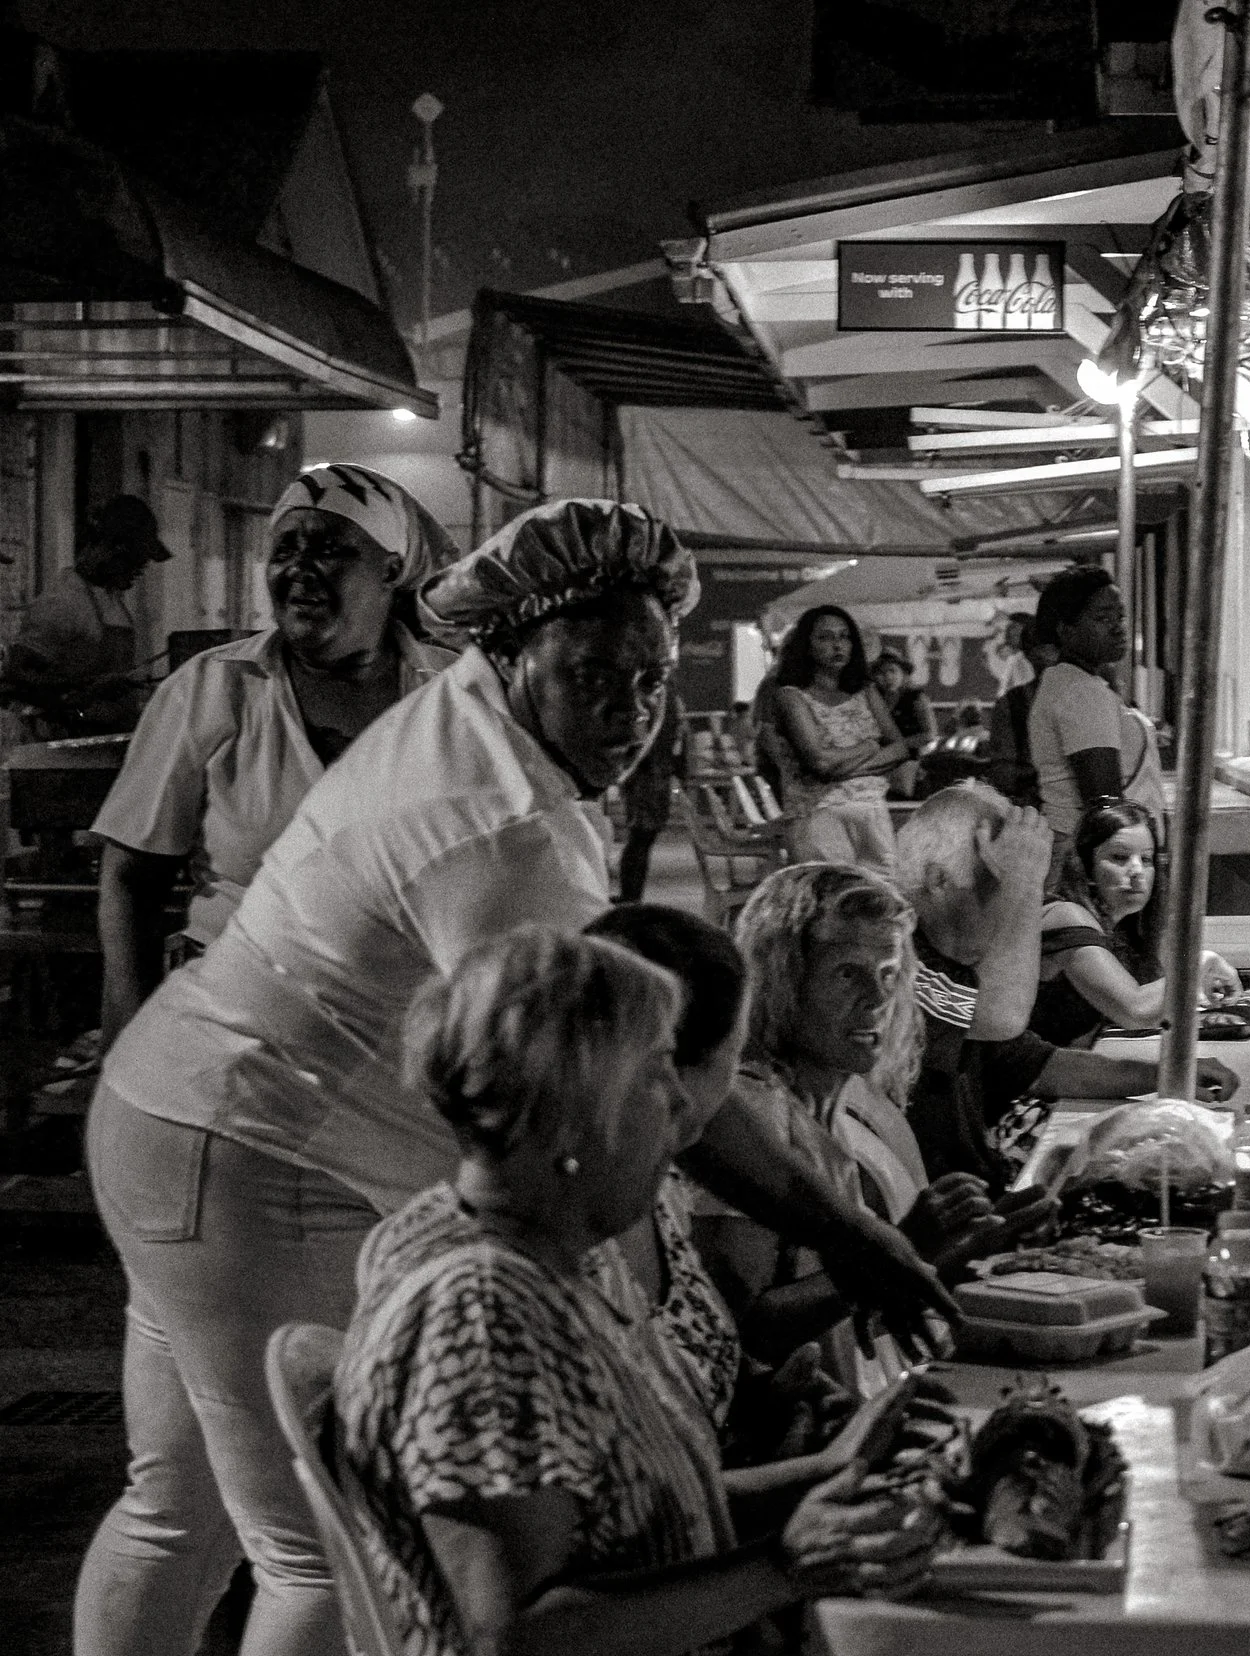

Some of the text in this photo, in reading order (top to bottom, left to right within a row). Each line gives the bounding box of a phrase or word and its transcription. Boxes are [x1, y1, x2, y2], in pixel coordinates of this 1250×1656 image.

[851, 271, 945, 286] Now serving
[877, 286, 914, 298] with
[954, 280, 1056, 314] Coca-Cola
